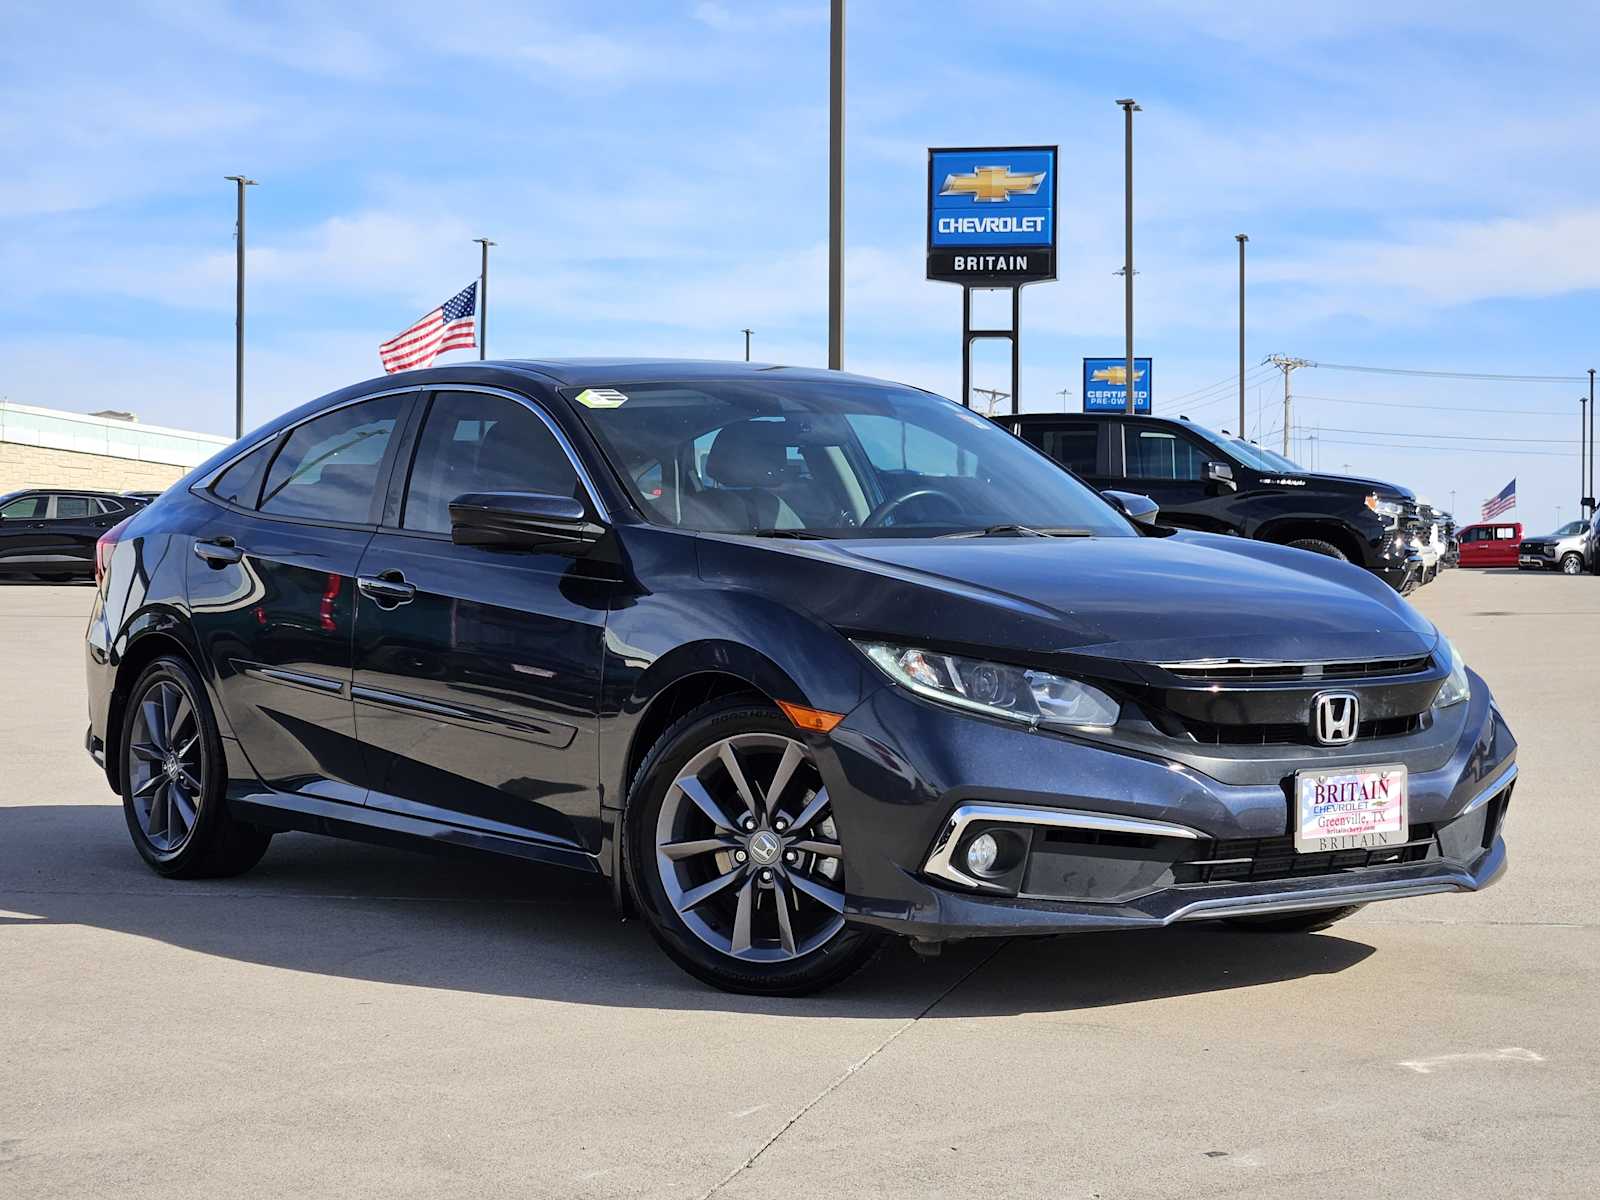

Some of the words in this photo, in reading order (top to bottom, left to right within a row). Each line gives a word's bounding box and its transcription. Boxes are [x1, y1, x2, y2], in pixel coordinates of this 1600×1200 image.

[938, 216, 1045, 233] CHEVROLET
[954, 256, 1028, 271] BRITAIN
[1314, 778, 1390, 805] BRITAIN
[1313, 801, 1369, 815] CHEVROLET
[1318, 813, 1369, 829] Greenville,
[1372, 810, 1386, 823] TX
[1319, 832, 1388, 851] BRITAIN
